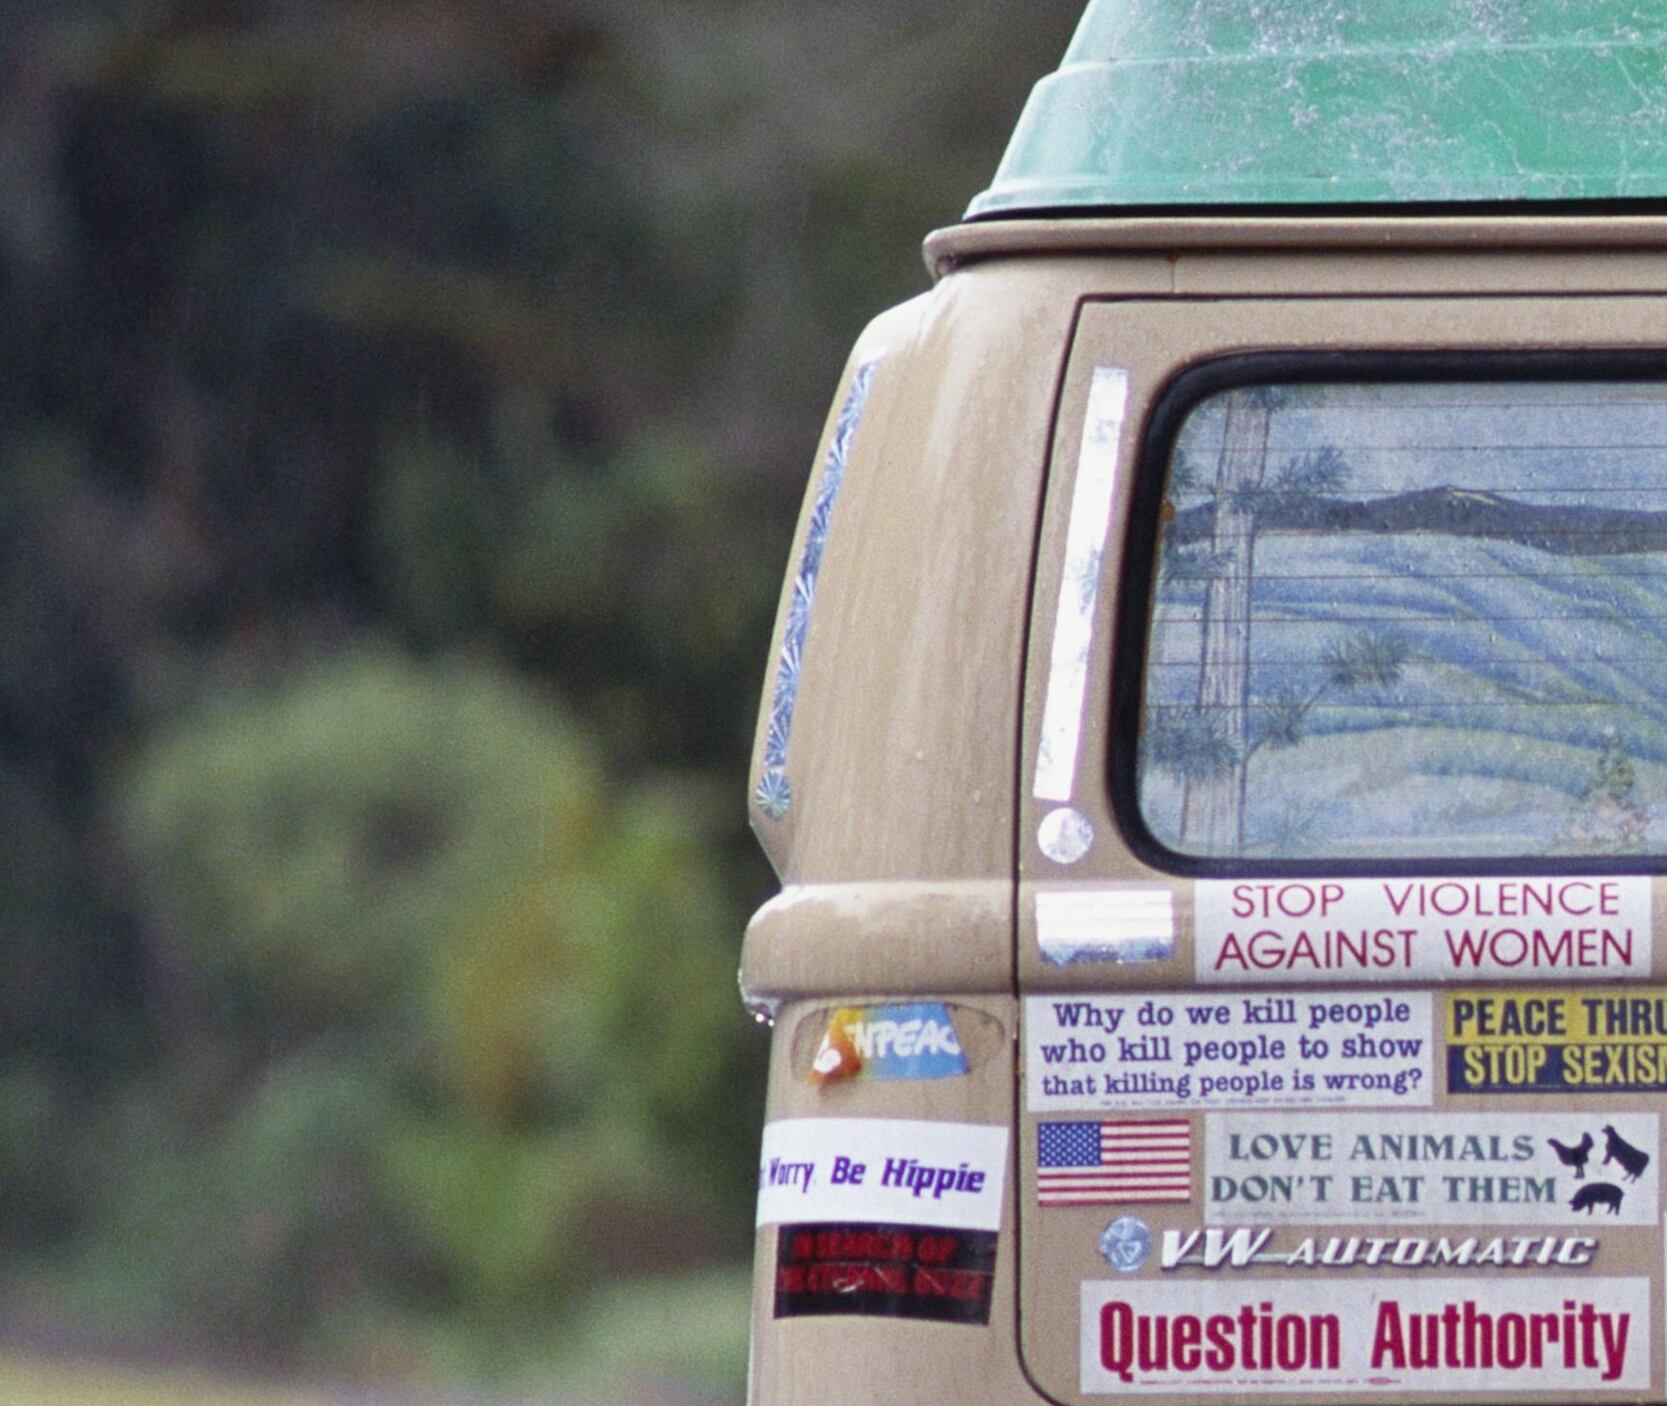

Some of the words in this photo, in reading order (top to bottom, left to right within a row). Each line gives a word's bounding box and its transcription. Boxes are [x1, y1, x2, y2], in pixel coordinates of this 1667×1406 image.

[1232, 884, 1344, 918] STOP
[1384, 882, 1619, 916] VIOLENCE
[1214, 929, 1417, 970] AGAINST
[1445, 928, 1633, 967] WOMEN
[1053, 1002, 1125, 1033] Why
[1138, 1001, 1173, 1026] do
[1186, 1006, 1230, 1024] we
[1244, 998, 1297, 1024] kill
[1309, 999, 1411, 1028] people
[1453, 998, 1566, 1037] PEACE
[1041, 1039, 1106, 1063] who
[1118, 1037, 1172, 1062] kill
[1183, 1035, 1285, 1066] people
[1298, 1035, 1329, 1060] to
[1341, 1033, 1423, 1059] show
[1464, 1045, 1547, 1084] STOP
[1042, 1074, 1096, 1095] that
[1104, 1073, 1191, 1098] killing
[1199, 1069, 1284, 1096] people
[1292, 1071, 1315, 1091] is
[1323, 1068, 1423, 1094] wrong?
[1229, 1134, 1333, 1160] LOVE
[1350, 1133, 1535, 1160] ANIMALS
[831, 1156, 866, 1184] Be
[881, 1158, 986, 1199] Hippie
[1212, 1176, 1333, 1202] DON'T
[1351, 1176, 1424, 1202] EAT
[1443, 1176, 1557, 1202] THEM
[1160, 1227, 1273, 1270] VW
[1286, 1236, 1601, 1266] AUTOMATIC
[1100, 1301, 1339, 1382] Question
[1370, 1301, 1630, 1381] Authority
